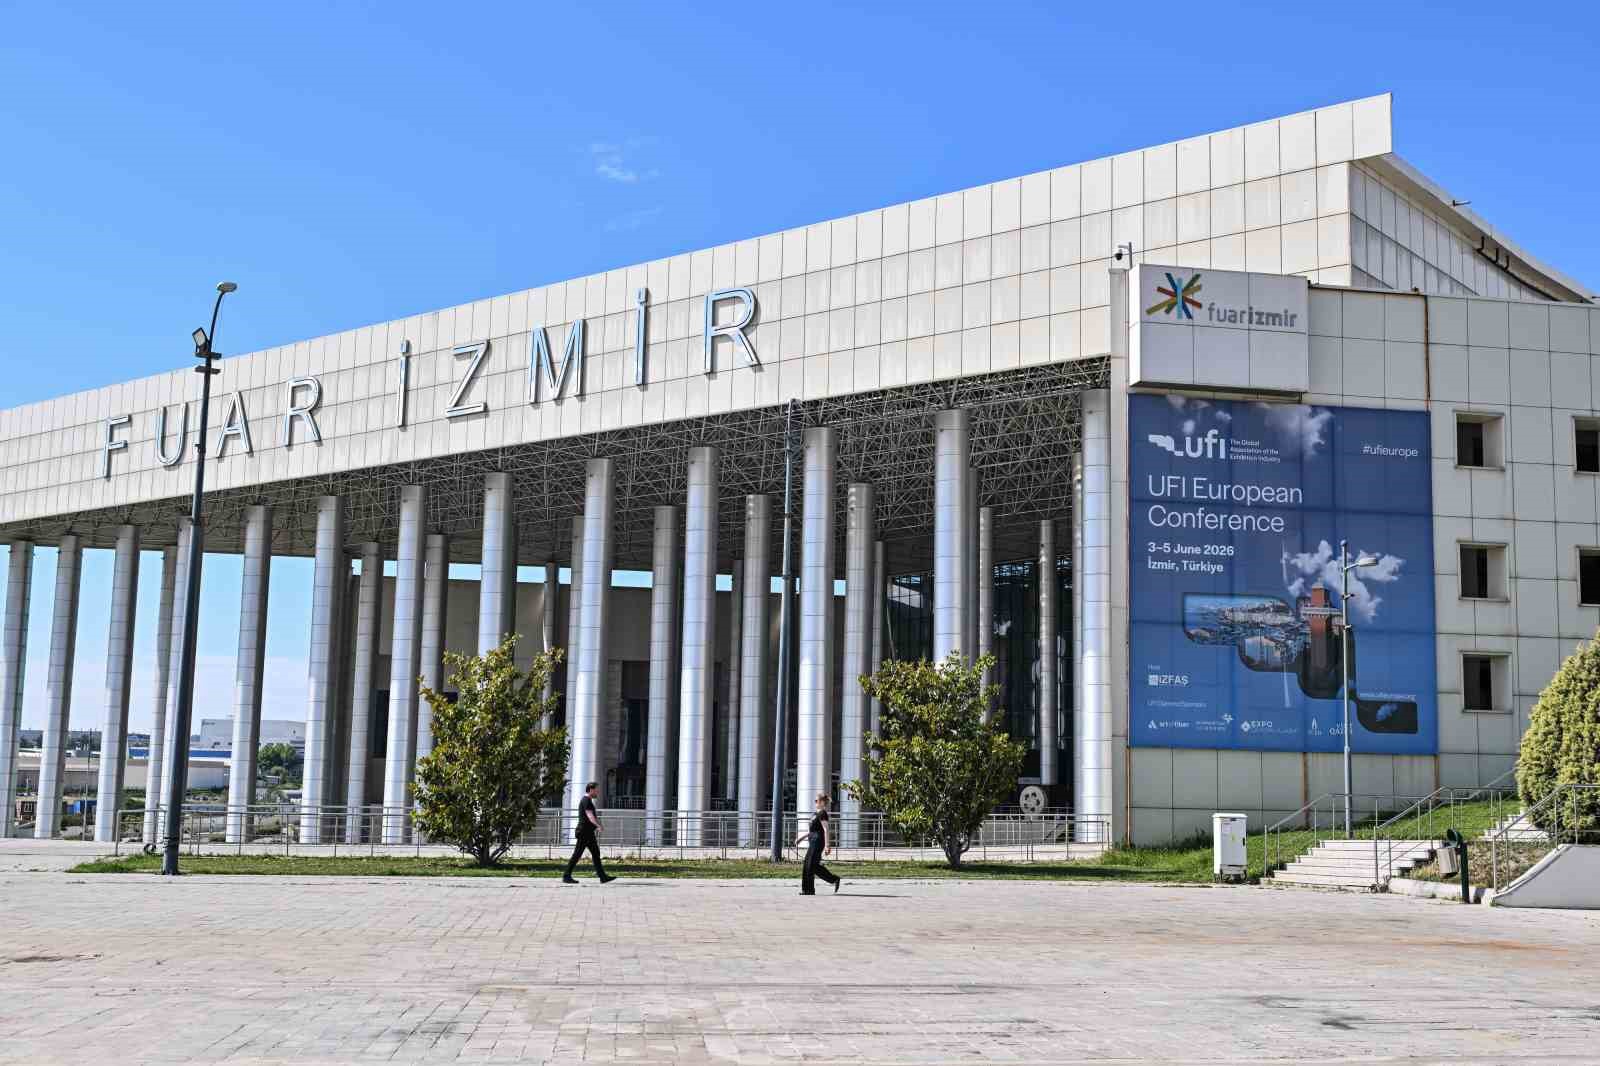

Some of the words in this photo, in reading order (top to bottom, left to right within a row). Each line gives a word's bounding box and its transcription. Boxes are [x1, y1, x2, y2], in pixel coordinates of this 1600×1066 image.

[1208, 303, 1298, 328] fuarizmir
[104, 376, 322, 479] FUAR
[396, 288, 761, 428] İZMİR
[1185, 429, 1226, 460] ufi
[1363, 444, 1419, 460] #ufieurope
[1148, 475, 1186, 498] UFI
[1193, 477, 1303, 506] European
[1148, 505, 1285, 532] Conference
[1173, 543, 1201, 556] June
[1203, 544, 1234, 556] 2026
[1148, 555, 1180, 572] İzmir,
[1182, 557, 1224, 574] Türkiye
